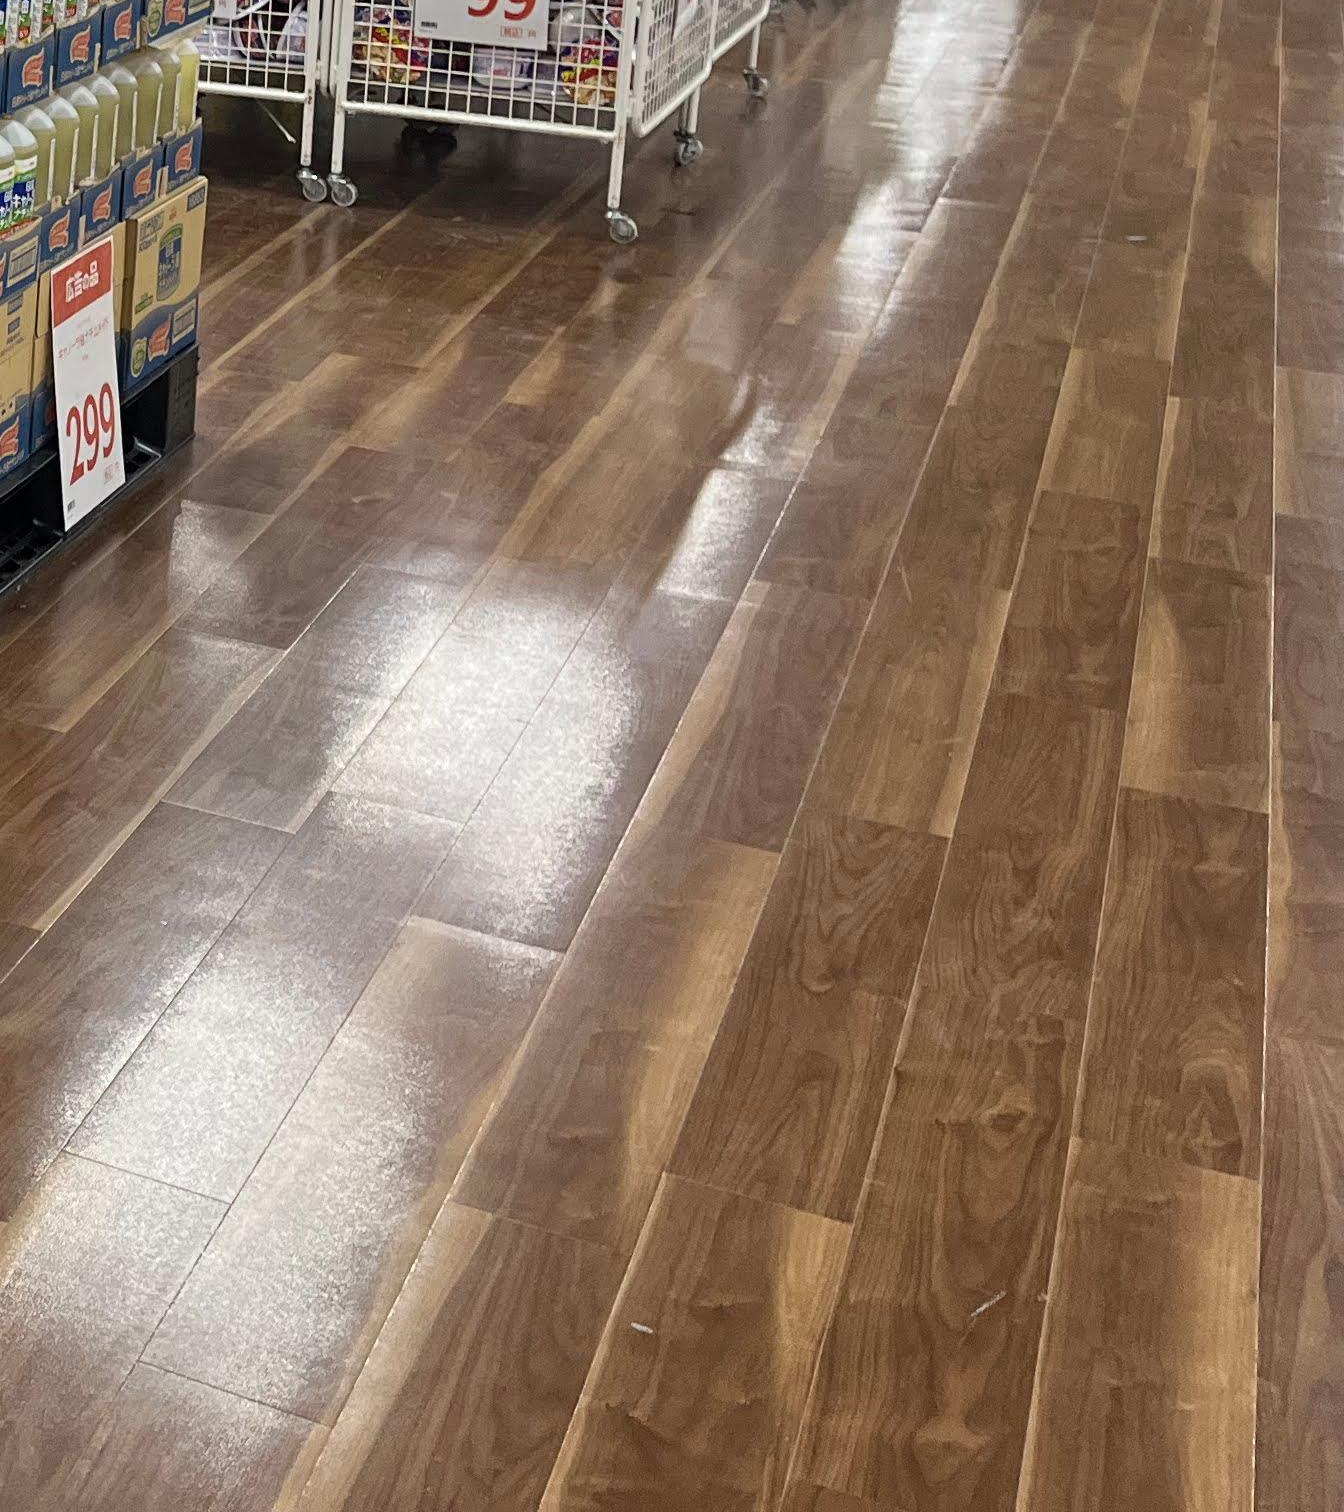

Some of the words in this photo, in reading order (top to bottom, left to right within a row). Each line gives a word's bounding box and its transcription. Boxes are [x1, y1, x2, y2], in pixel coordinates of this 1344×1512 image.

[66, 260, 99, 303] 広告の品
[66, 382, 113, 485] 299
